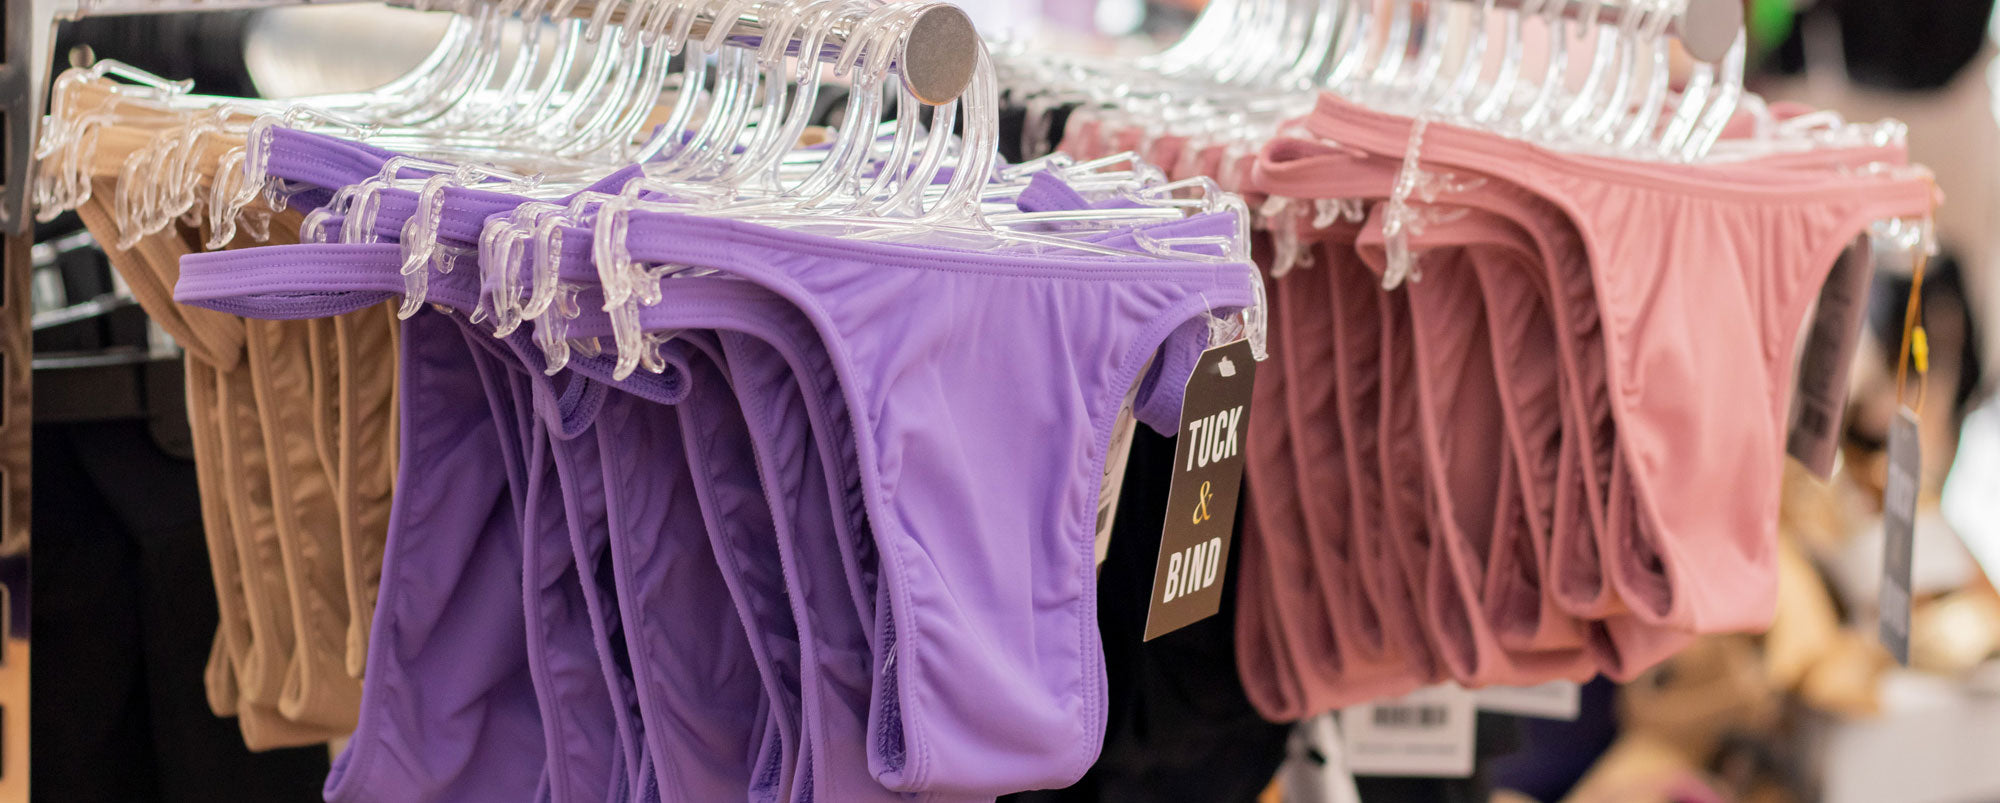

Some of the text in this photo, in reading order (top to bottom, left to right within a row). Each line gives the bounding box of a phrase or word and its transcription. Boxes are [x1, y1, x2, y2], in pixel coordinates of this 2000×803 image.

[1187, 406, 1243, 471] TUCK
[1193, 481, 1213, 524] &
[1164, 538, 1221, 603] BIND
